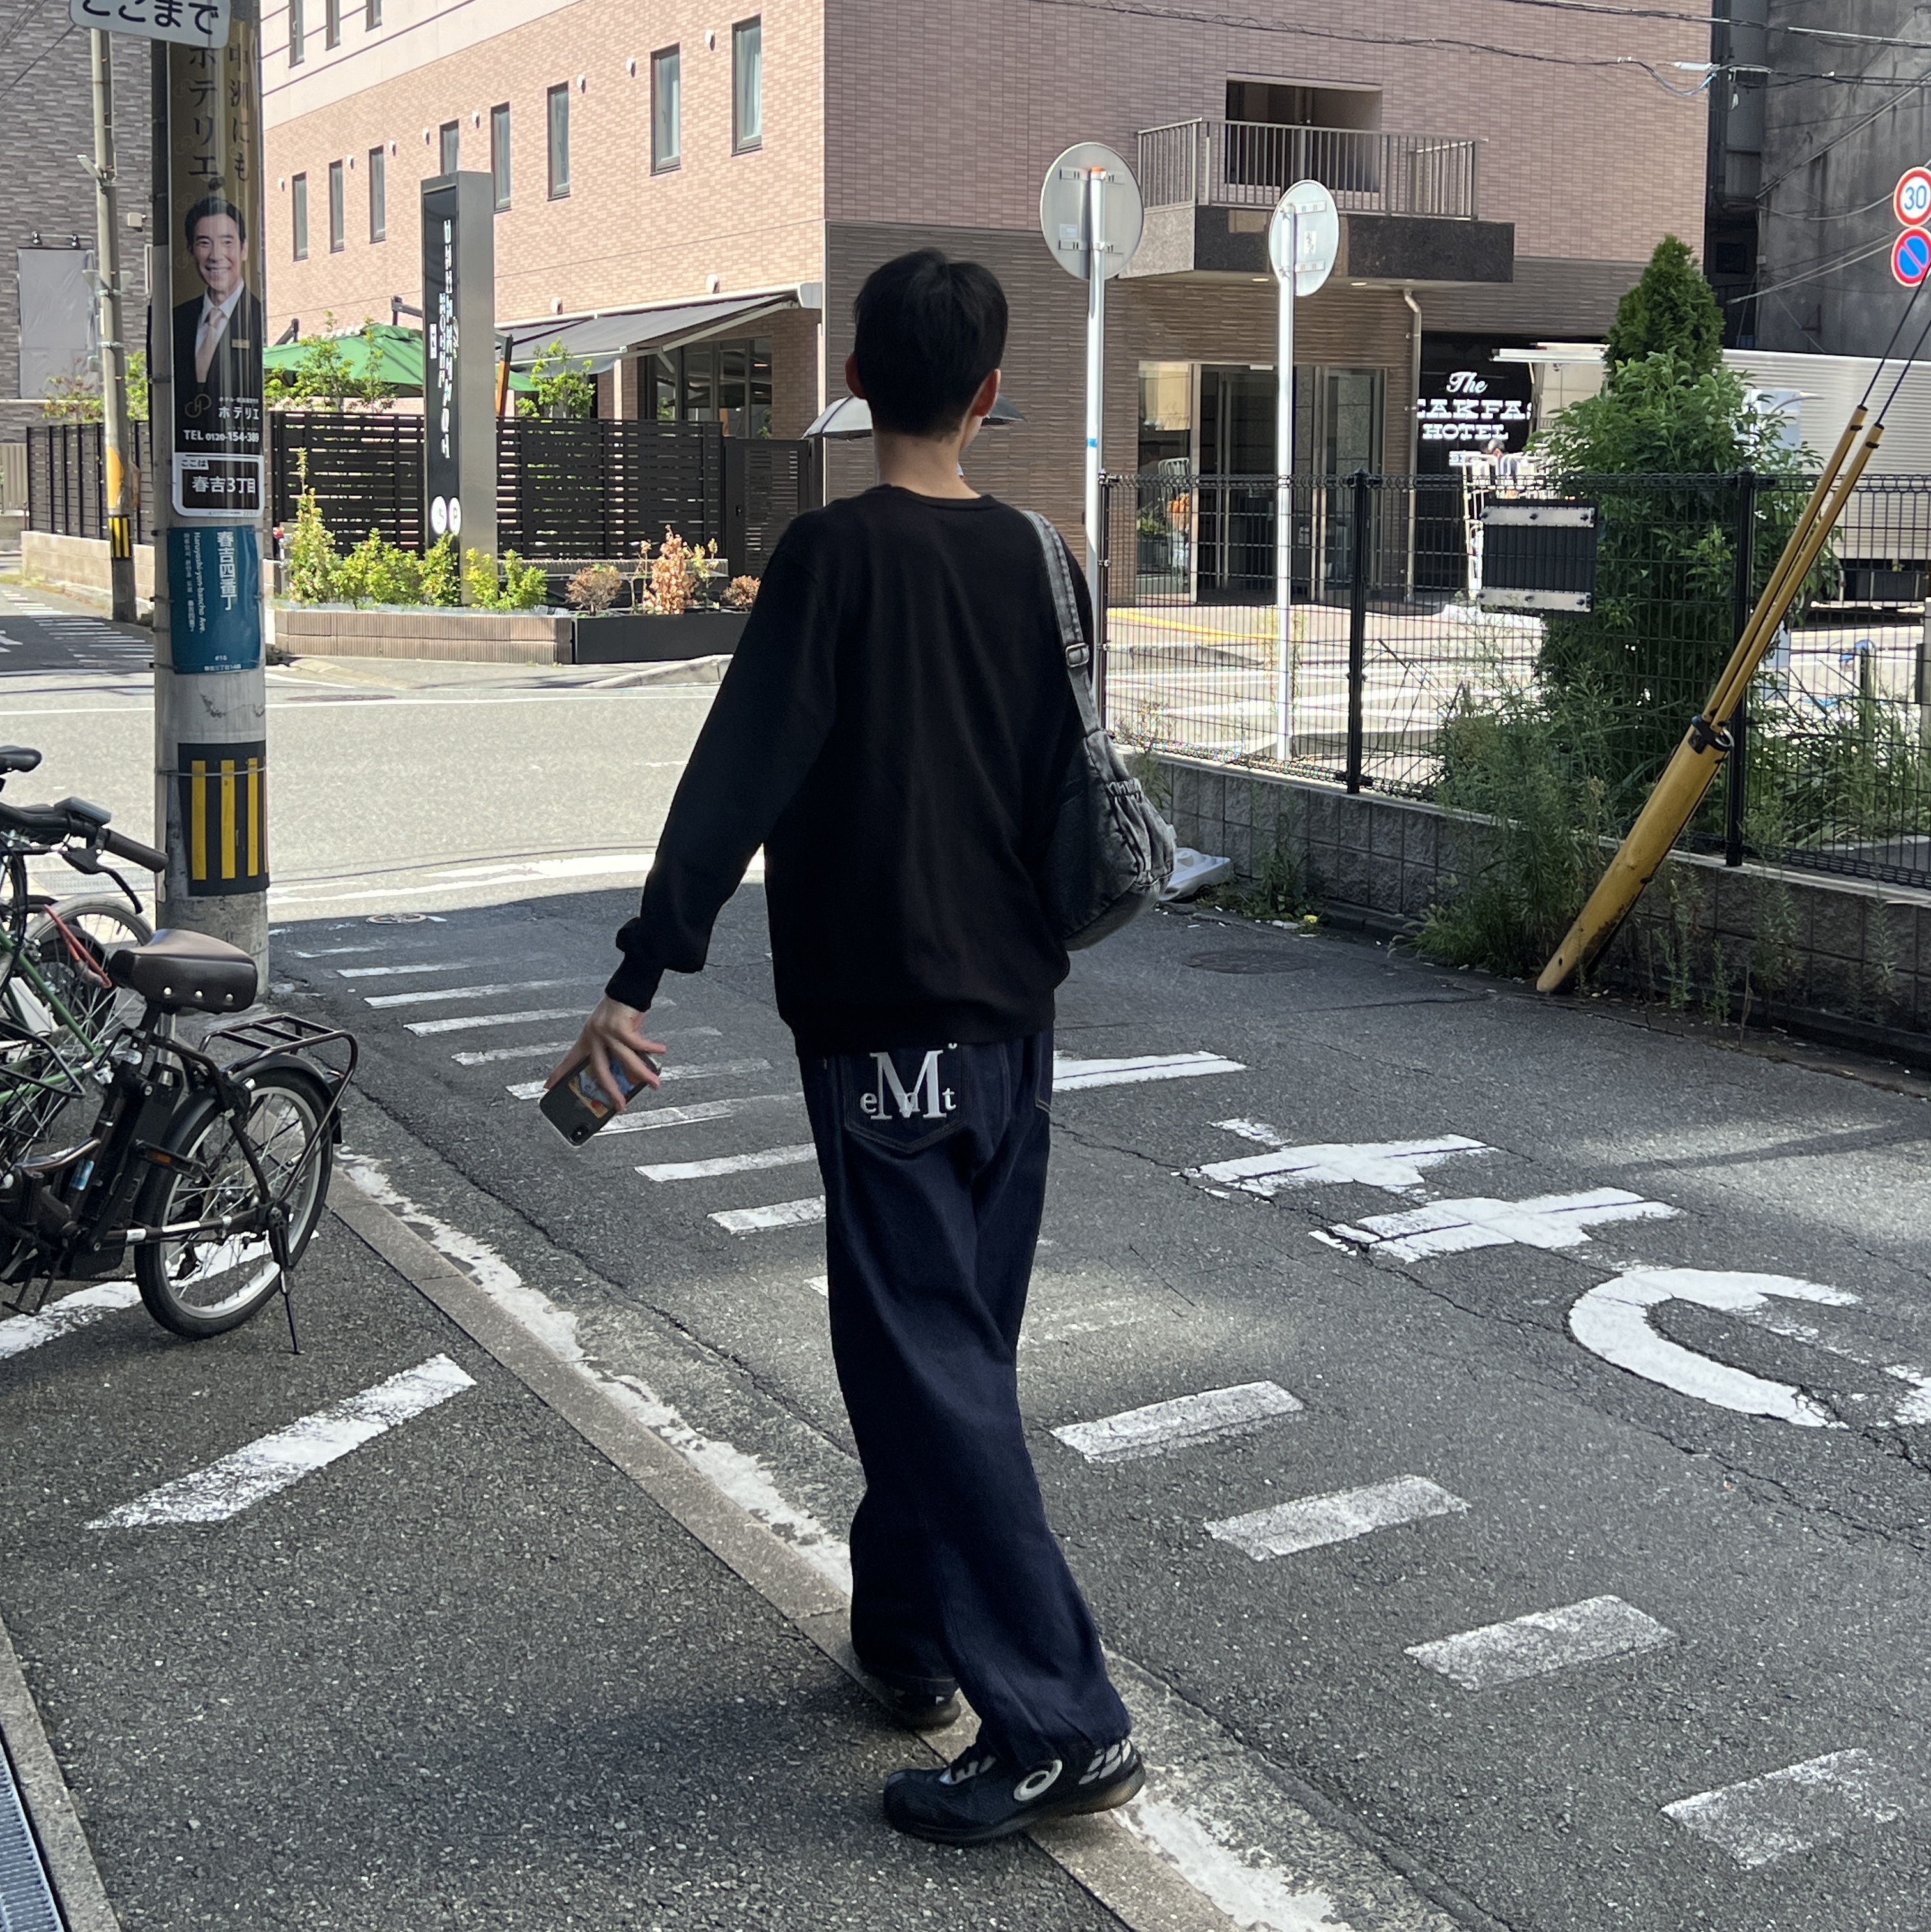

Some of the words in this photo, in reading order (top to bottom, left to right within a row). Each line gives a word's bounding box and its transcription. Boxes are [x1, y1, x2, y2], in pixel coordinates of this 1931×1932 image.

[1904, 185, 1927, 210] 30
[438, 293, 446, 389] HOTEL
[1446, 371, 1488, 393] The
[218, 406, 260, 420] ホテリエ
[183, 430, 204, 441] TEL
[1422, 423, 1509, 441] HOTEL
[181, 459, 207, 468] ここは
[192, 475, 256, 494] 春吉3丁目
[217, 531, 238, 611] 春吉四番丁
